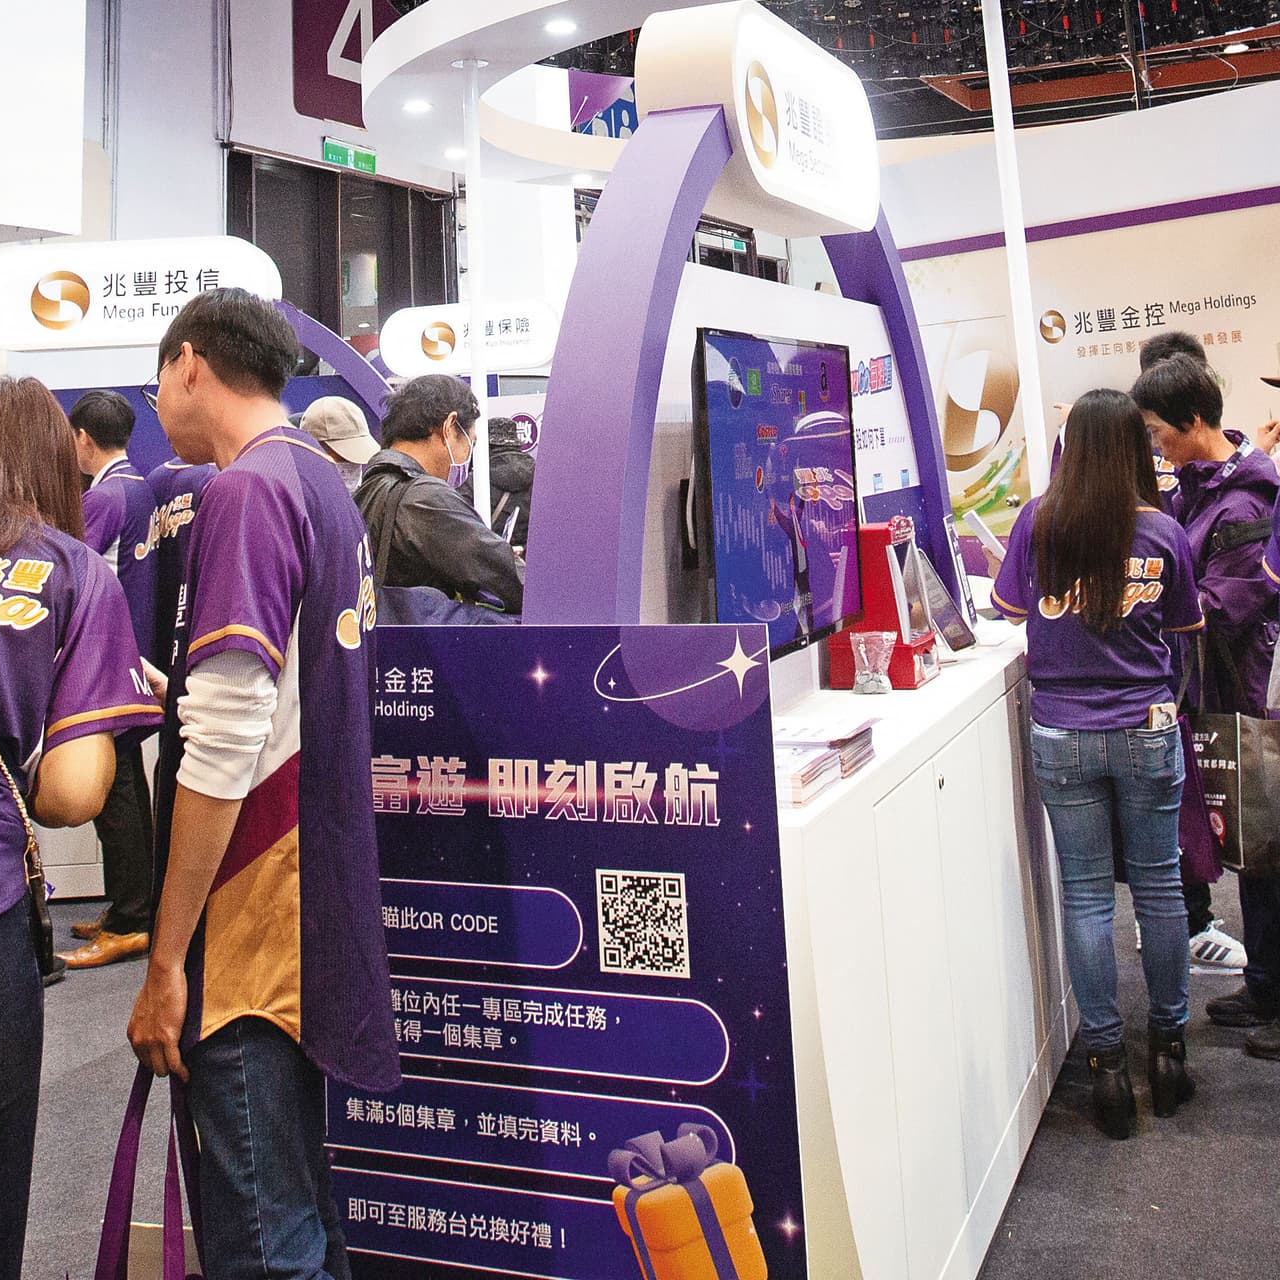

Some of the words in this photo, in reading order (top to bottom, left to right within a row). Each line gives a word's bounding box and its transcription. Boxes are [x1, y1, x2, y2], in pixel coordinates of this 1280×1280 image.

[102, 268, 220, 298] 兆豐投信
[103, 304, 145, 323] Mega
[152, 302, 180, 317] Fun
[1170, 299, 1201, 315] Mega
[1204, 293, 1257, 310] Holdings
[1073, 302, 1166, 335] 兆豐金控
[1196, 329, 1244, 346] 續發展
[375, 666, 435, 694] 金控
[375, 701, 435, 721] Holdings
[371, 754, 468, 817] 富遊
[487, 757, 721, 827] 即刻啟航
[450, 913, 499, 934] CODE
[346, 1096, 597, 1148] 集滿5個集章，並填完資料。
[347, 1197, 567, 1250] 即可至服務台兌換好禮！
